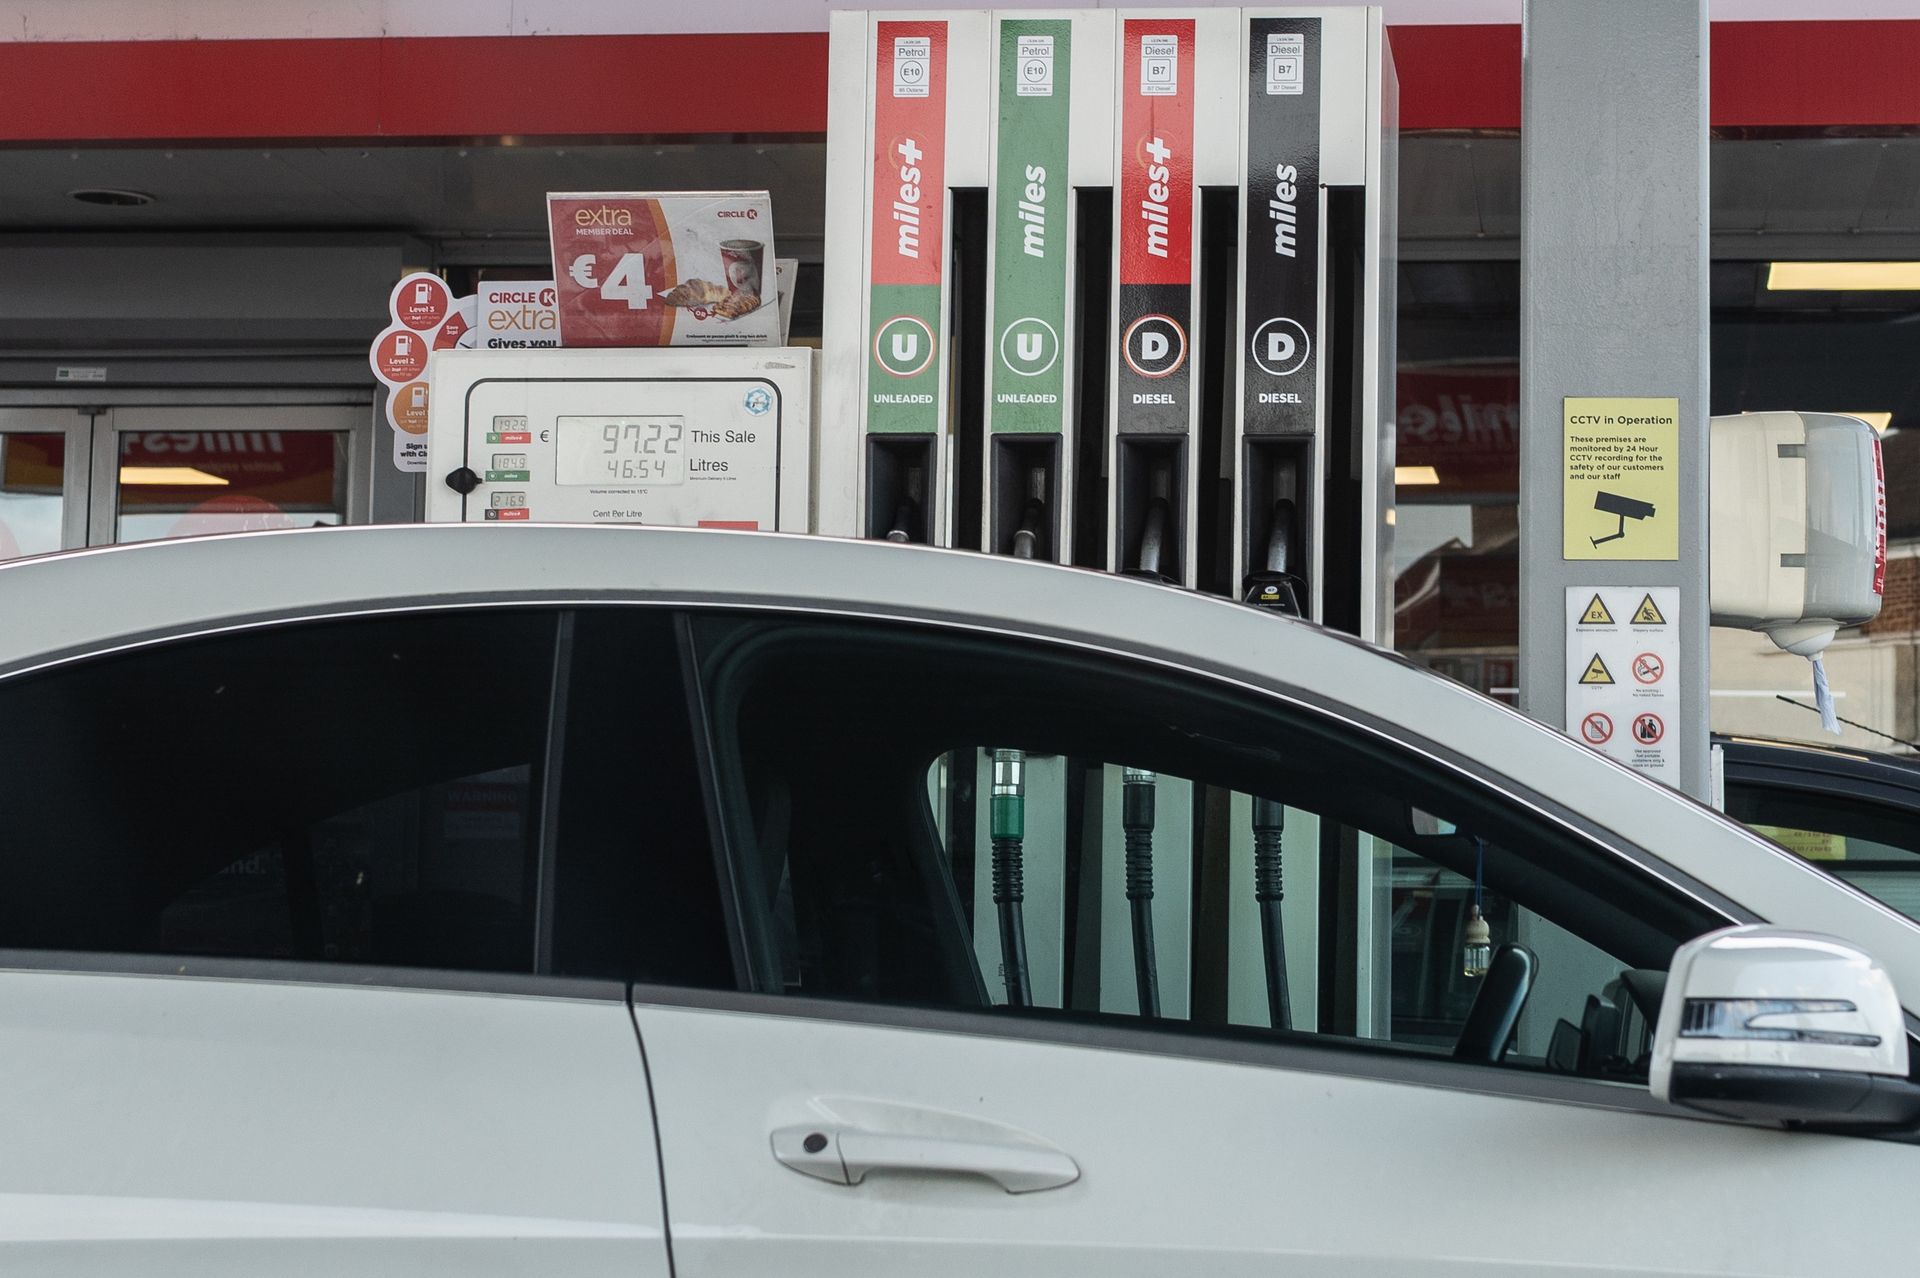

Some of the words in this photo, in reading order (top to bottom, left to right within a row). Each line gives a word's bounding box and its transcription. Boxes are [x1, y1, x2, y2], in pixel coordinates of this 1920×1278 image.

[898, 46, 926, 57] Petrol
[1022, 45, 1050, 56] Petrol
[1145, 46, 1175, 55] Diesel
[1271, 45, 1300, 54] Diesel
[903, 67, 920, 76] E10
[1026, 66, 1044, 75] E10
[1152, 66, 1166, 75] B7
[1278, 65, 1292, 74] B7
[575, 204, 632, 226] extra
[1018, 164, 1047, 258] miles
[1269, 163, 1298, 258] miles
[576, 228, 612, 236] MEMBER
[612, 228, 634, 236] DEAL
[489, 292, 536, 304] CIRCLE
[488, 304, 556, 330] extra
[488, 338, 527, 349] Gives
[892, 333, 918, 362] U
[1017, 333, 1043, 361] U
[1141, 332, 1169, 360] D
[1268, 332, 1296, 361] D
[873, 394, 933, 404] UNLEADED
[997, 393, 1057, 404] UNLEADED
[1132, 393, 1175, 404] DIESEL
[1258, 393, 1302, 404] DIESEL
[1570, 415, 1601, 425] CCTV
[1604, 415, 1614, 425] in
[1617, 415, 1673, 426] Operation
[540, 429, 550, 442] €
[691, 430, 720, 443] This
[725, 429, 756, 443] Sale
[1595, 436, 1632, 444] premises
[1613, 445, 1624, 454] by
[1569, 454, 1592, 462] CCTV
[1594, 454, 1634, 463] recording
[1635, 454, 1648, 462] for
[1649, 454, 1663, 462] the
[689, 458, 729, 471] Litres
[1569, 464, 1594, 472] safety
[1596, 463, 1605, 471] of
[592, 509, 610, 518] Cent
[612, 510, 625, 518] Per
[626, 510, 643, 518] Litre
[1591, 611, 1603, 619] EX
